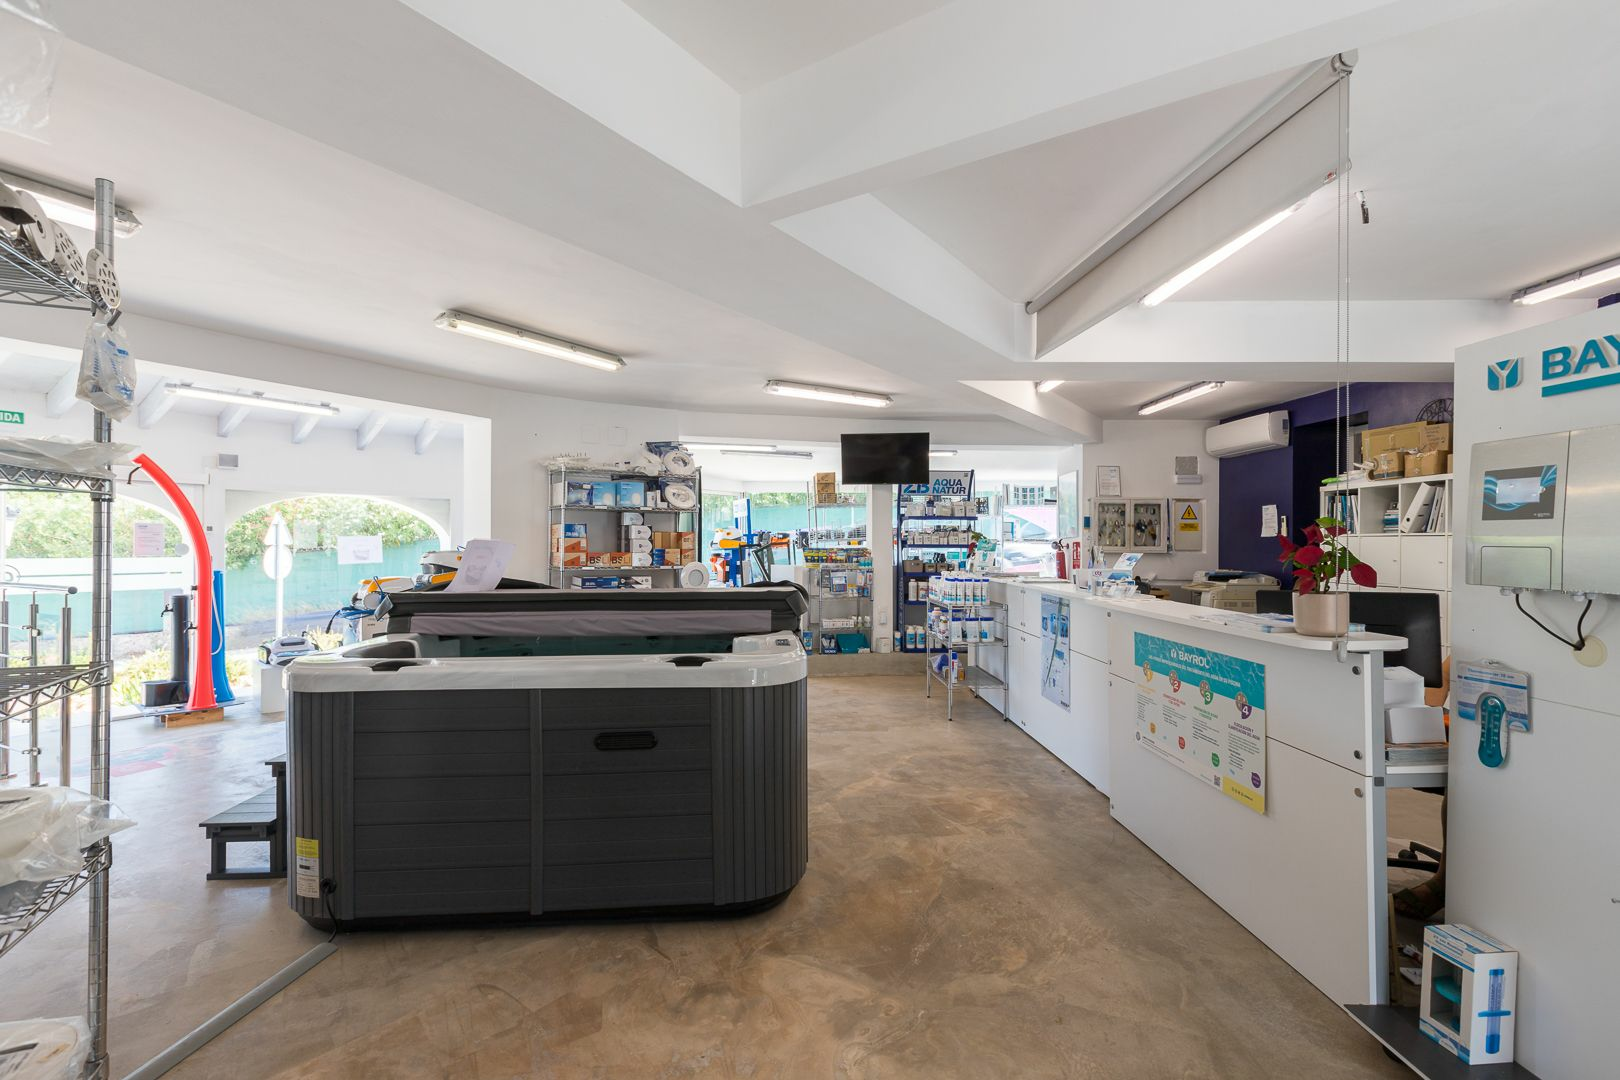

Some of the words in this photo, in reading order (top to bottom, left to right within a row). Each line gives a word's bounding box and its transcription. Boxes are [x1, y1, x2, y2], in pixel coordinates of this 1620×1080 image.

[933, 478, 963, 487] AQUA
[932, 486, 966, 494] NATUR
[1178, 651, 1210, 669] BAYROL
